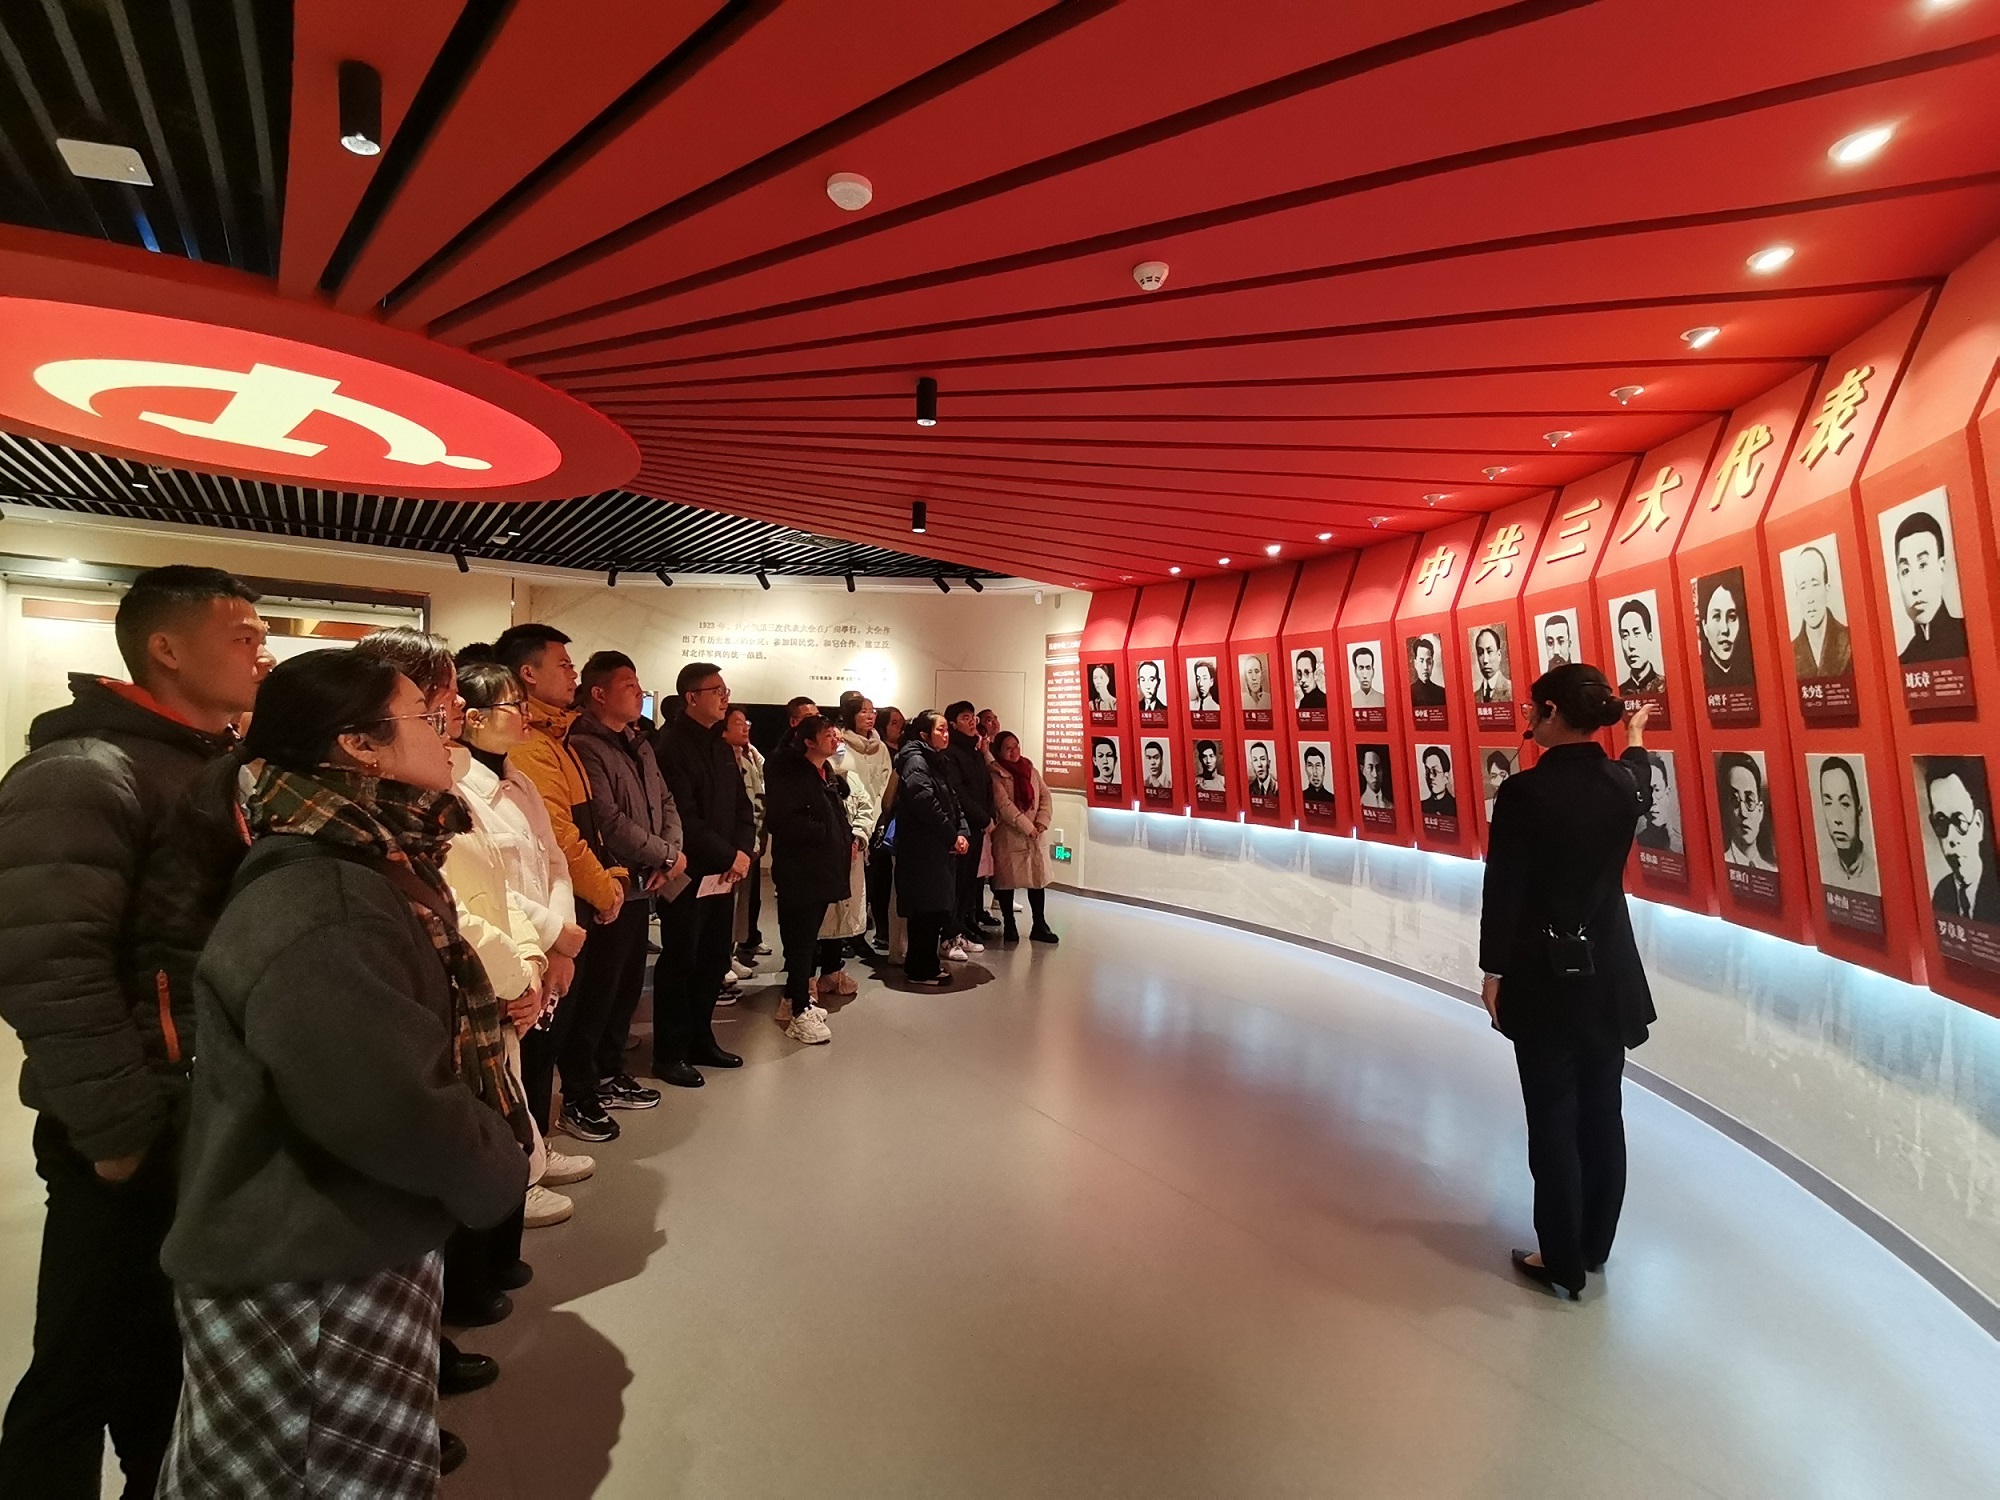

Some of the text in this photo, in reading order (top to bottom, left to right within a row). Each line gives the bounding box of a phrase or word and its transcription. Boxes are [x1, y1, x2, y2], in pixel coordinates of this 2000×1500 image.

[1416, 365, 1874, 595] 中共三大代表
